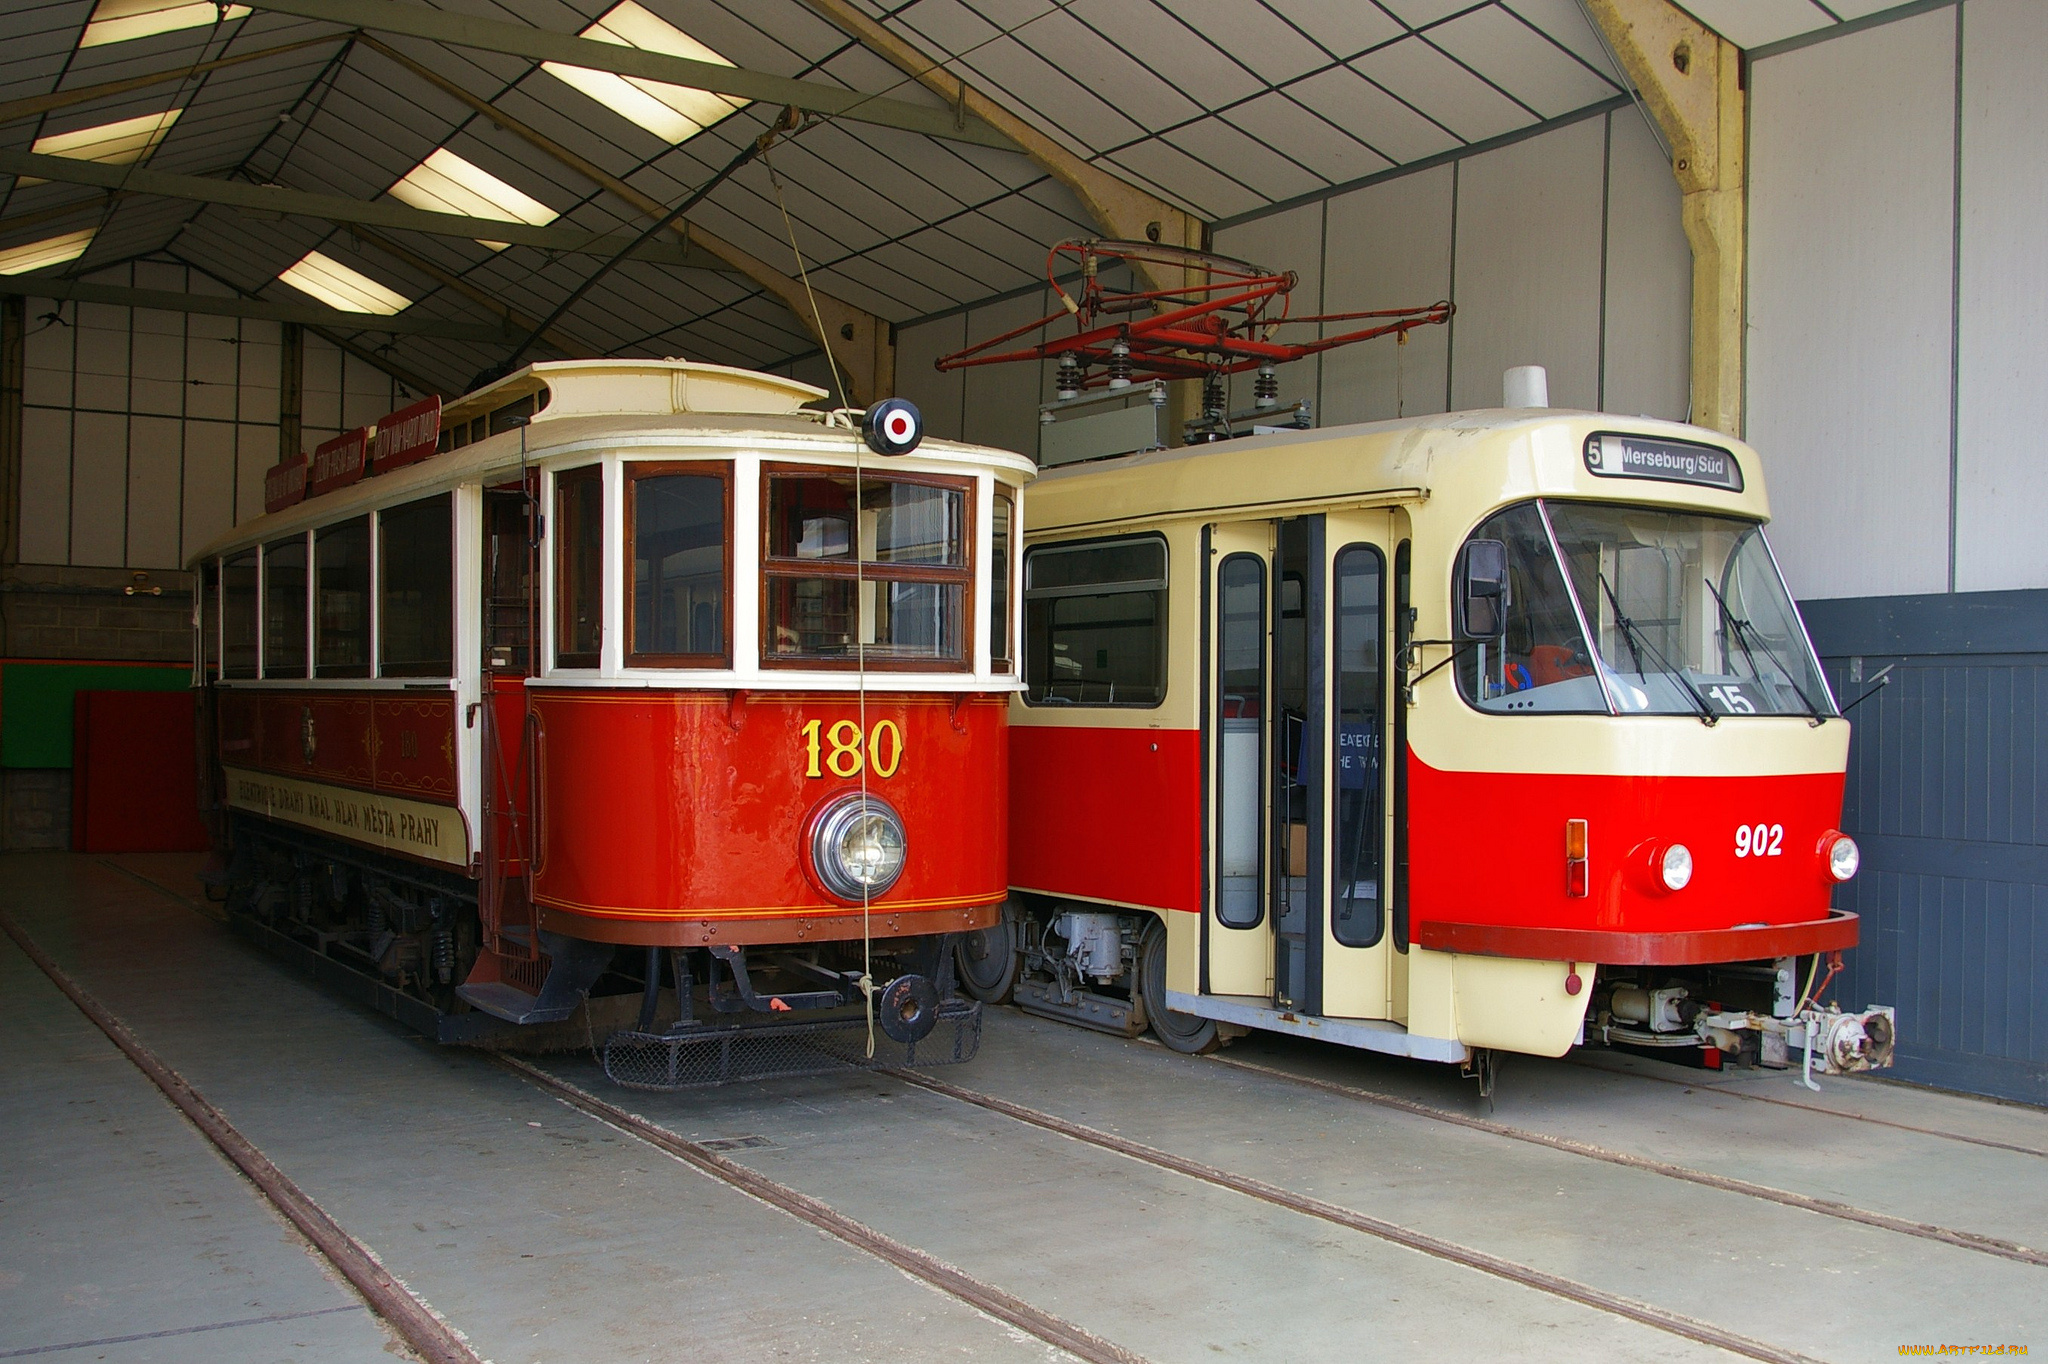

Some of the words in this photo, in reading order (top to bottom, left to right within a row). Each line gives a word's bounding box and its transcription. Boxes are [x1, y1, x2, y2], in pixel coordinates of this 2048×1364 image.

[1588, 441, 1601, 465] 5
[1622, 445, 1723, 475] Merseburg/Süd
[1709, 686, 1756, 714] 15
[802, 719, 903, 778] 180
[363, 804, 395, 838] MĚSTA
[400, 813, 439, 847] PRAHY
[1735, 823, 1783, 858] 902
